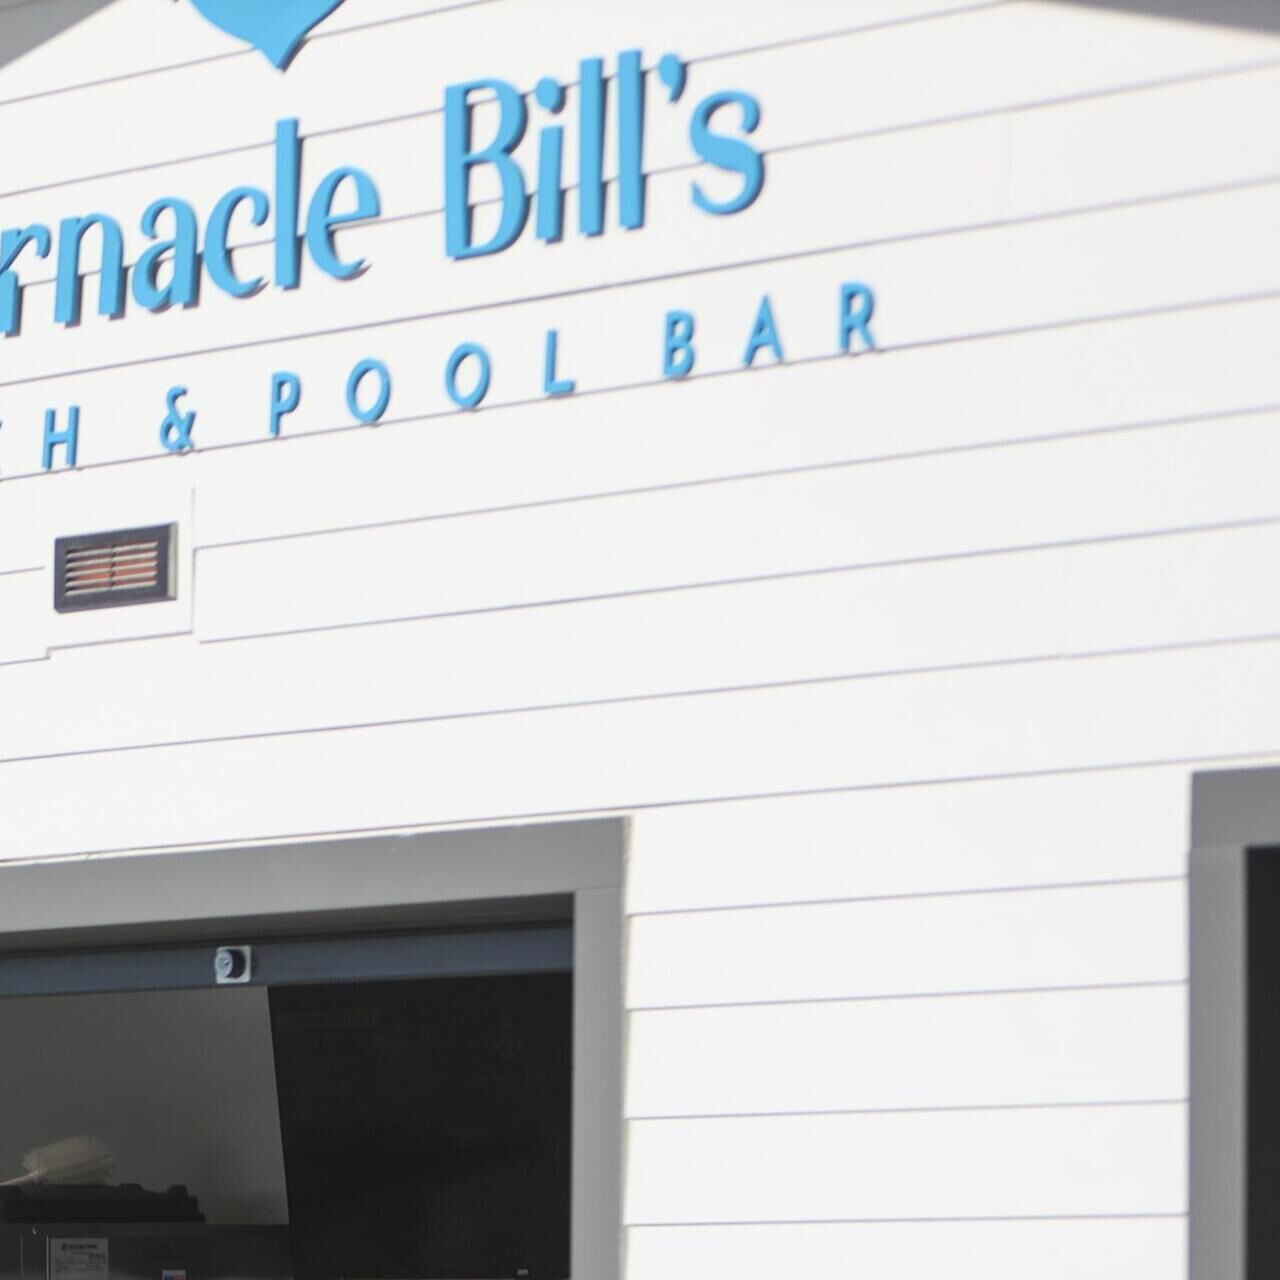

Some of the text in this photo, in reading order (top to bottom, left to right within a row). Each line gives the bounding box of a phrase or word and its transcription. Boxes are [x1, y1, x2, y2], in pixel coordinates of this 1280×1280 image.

[442, 48, 774, 261] Bill's
[159, 385, 196, 453] &
[269, 328, 577, 435] POOL
[661, 281, 876, 380] BAR
